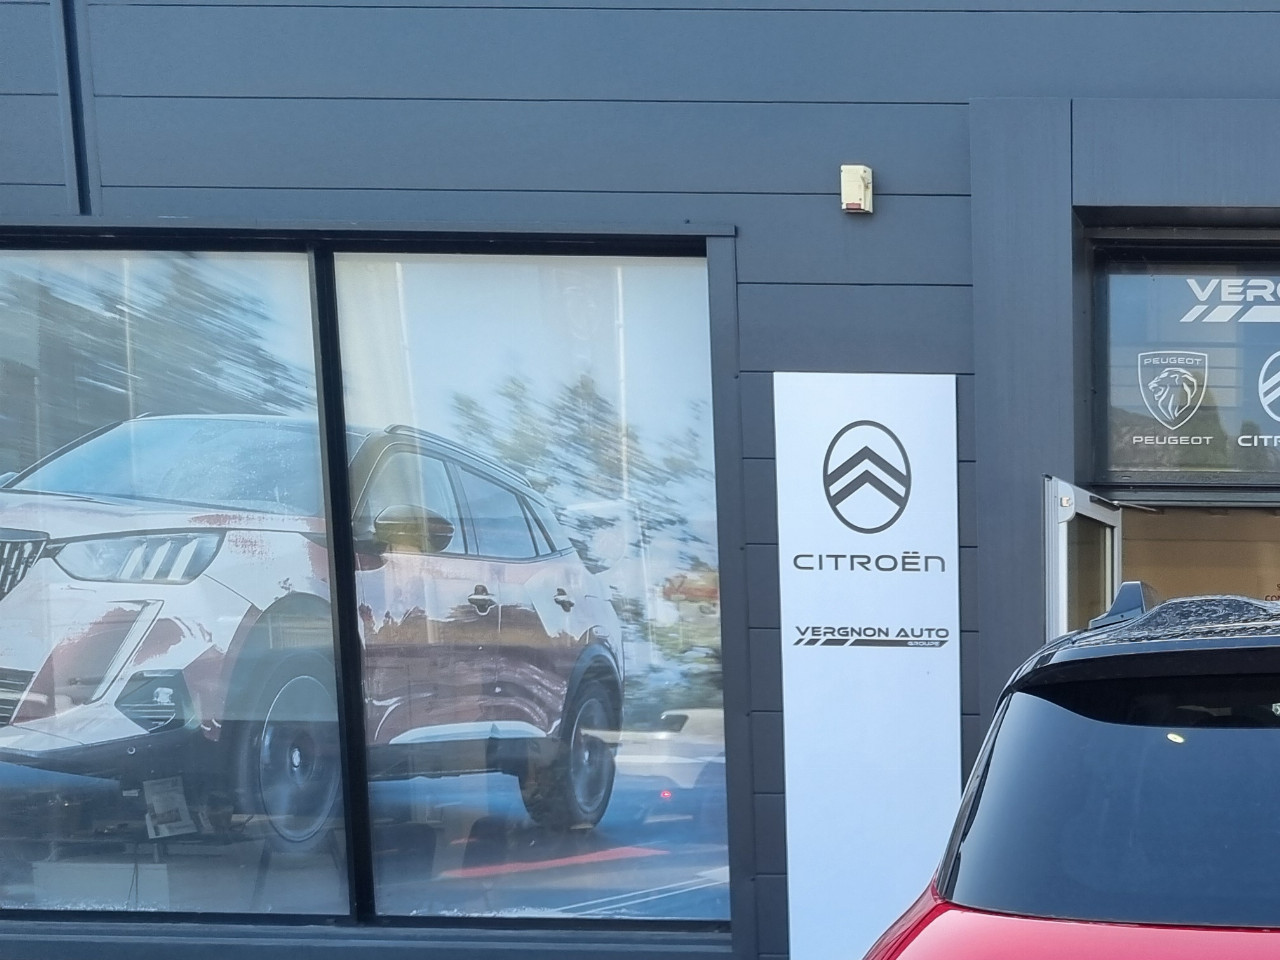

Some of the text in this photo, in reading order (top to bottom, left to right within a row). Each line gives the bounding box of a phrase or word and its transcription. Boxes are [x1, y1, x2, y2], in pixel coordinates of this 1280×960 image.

[1143, 357, 1202, 367] PEUGEOT
[1132, 436, 1213, 446] PEUGEOT
[795, 626, 949, 639] VERGNON AUTO
